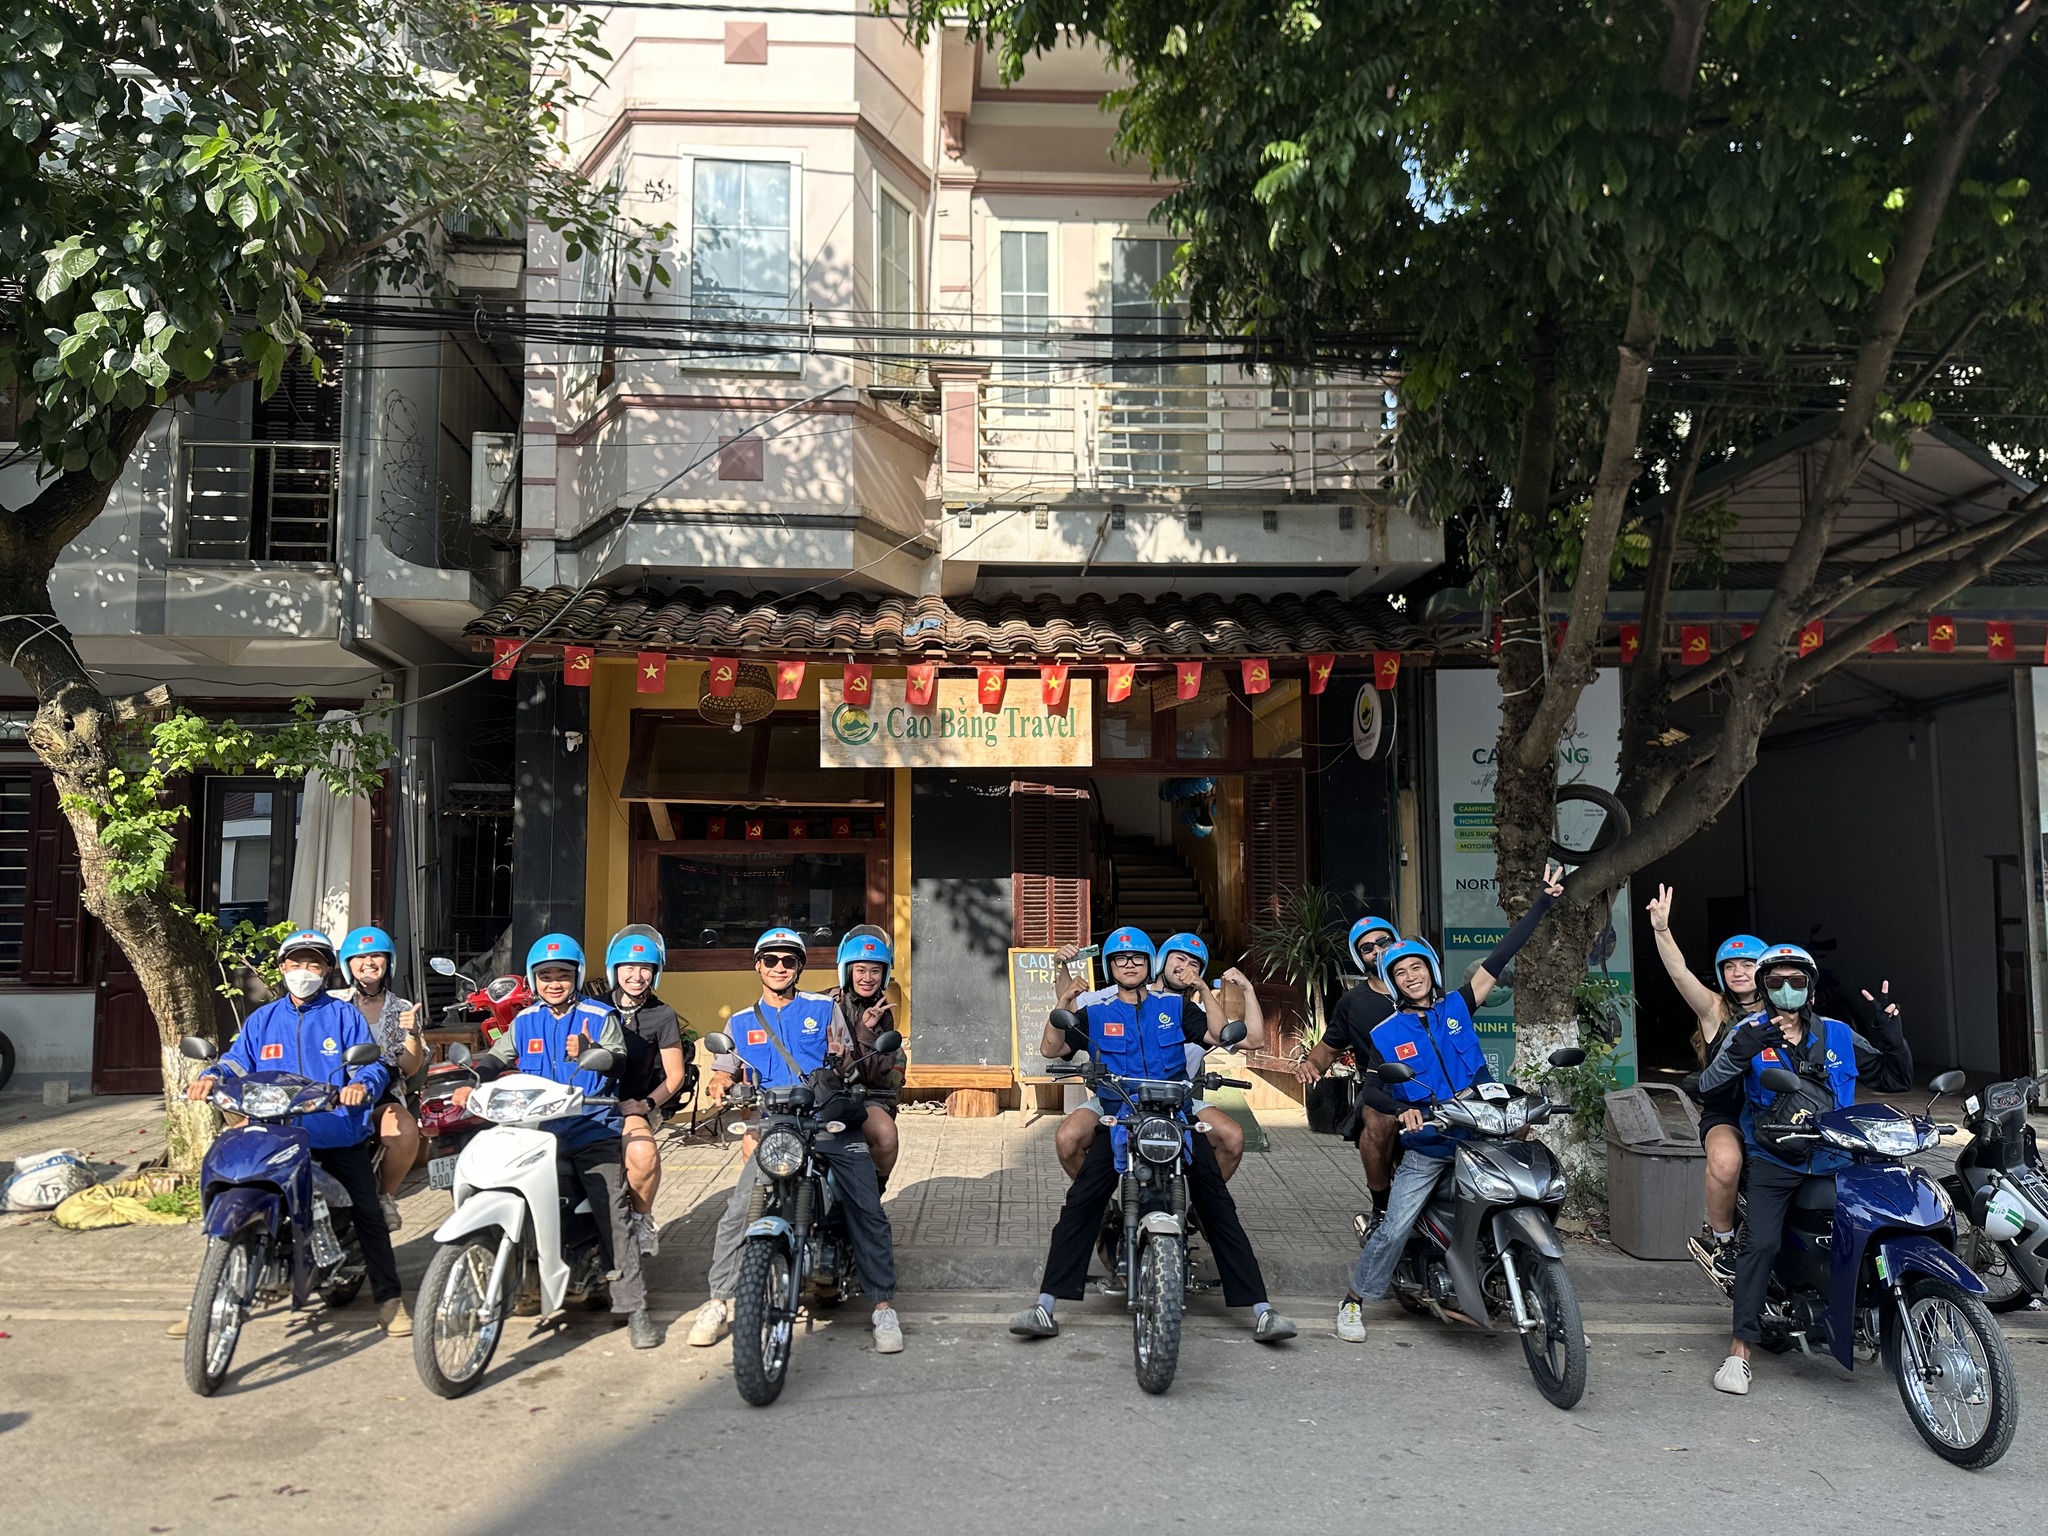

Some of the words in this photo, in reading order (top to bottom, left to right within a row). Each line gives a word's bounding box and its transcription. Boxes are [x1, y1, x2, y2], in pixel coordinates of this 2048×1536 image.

[886, 707, 932, 739] Cao
[938, 697, 998, 747] Bằng
[1003, 706, 1076, 739] Travel
[1472, 748, 1498, 765] CA
[1560, 748, 1590, 764] NG
[1455, 878, 1500, 890] NORT
[1452, 934, 1471, 943] HA
[1473, 934, 1504, 944] GIAN
[1473, 1022, 1508, 1033] NINH
[434, 1156, 459, 1174] 11-B
